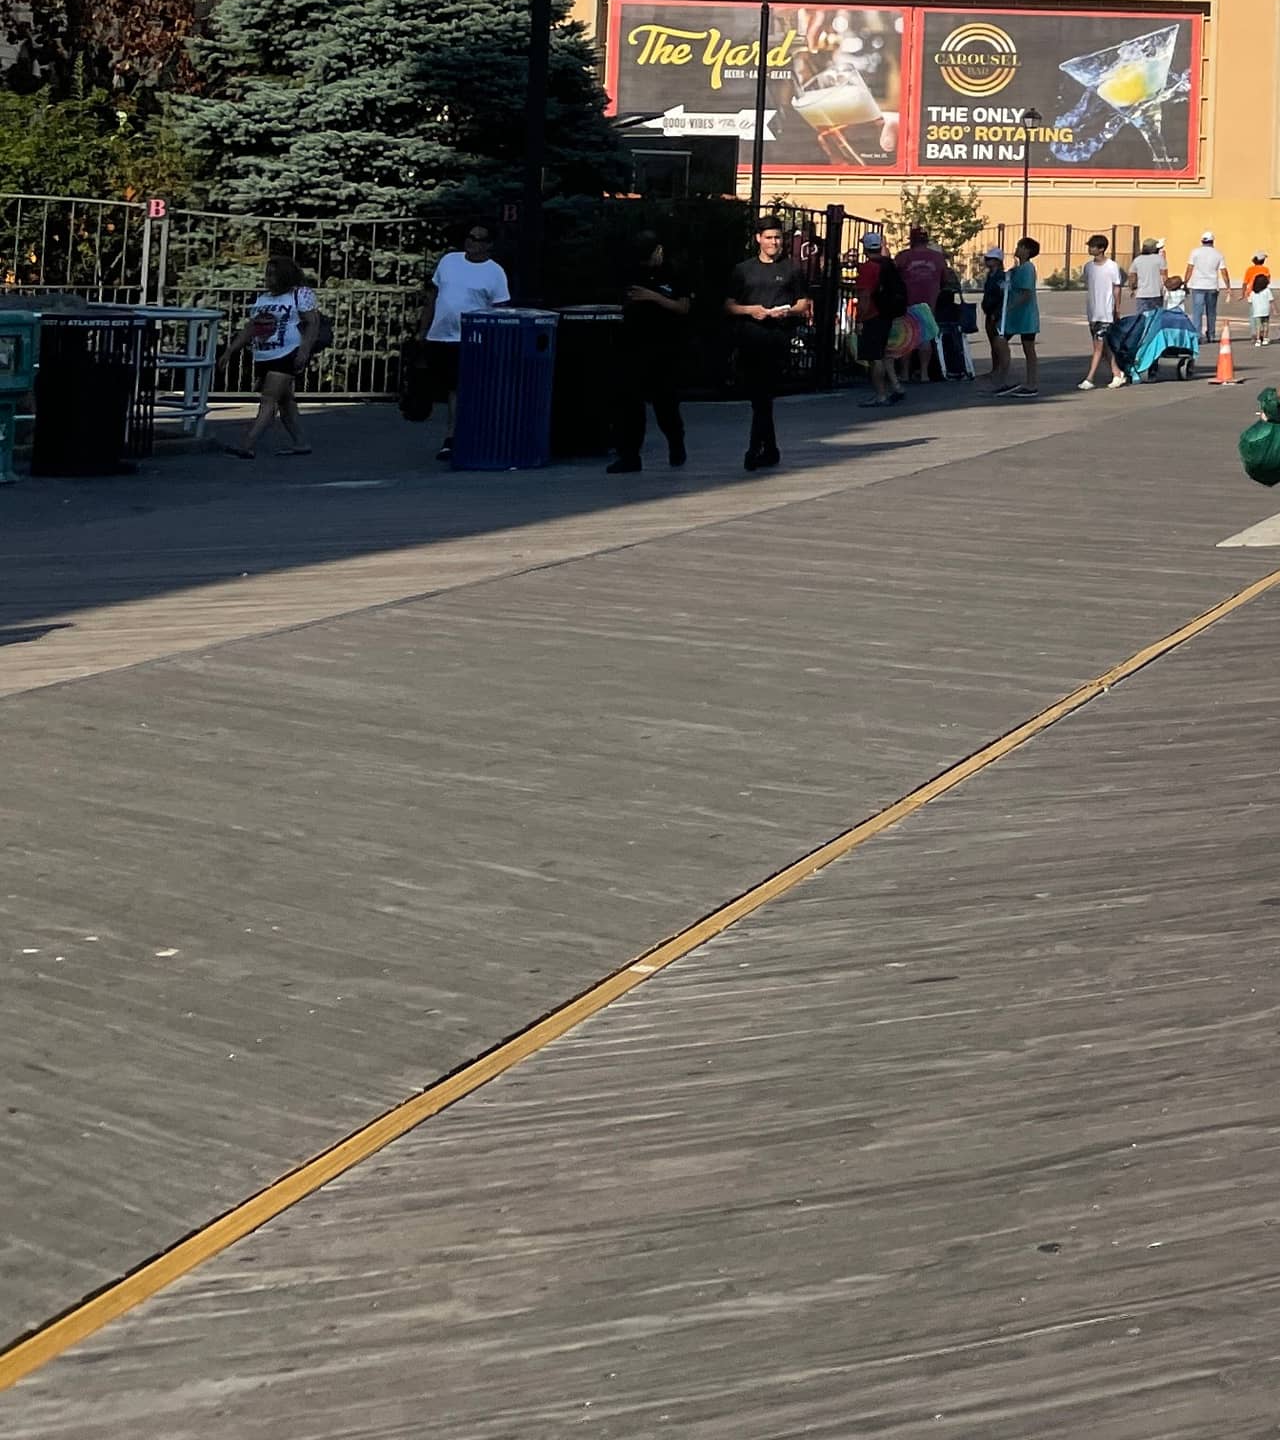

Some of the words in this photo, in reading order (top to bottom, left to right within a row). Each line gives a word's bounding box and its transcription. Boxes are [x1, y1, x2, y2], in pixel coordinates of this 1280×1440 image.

[628, 24, 707, 65] The
[702, 28, 797, 89] Yard
[934, 53, 1022, 66] CAROUSEL
[927, 106, 968, 122] THE
[972, 107, 1025, 124] ONLY
[927, 125, 971, 141] 360°
[974, 126, 1073, 142] ROTATING
[926, 143, 968, 159] BAR
[972, 144, 993, 160] IN
[999, 144, 1025, 161] NJ
[148, 199, 166, 218] B
